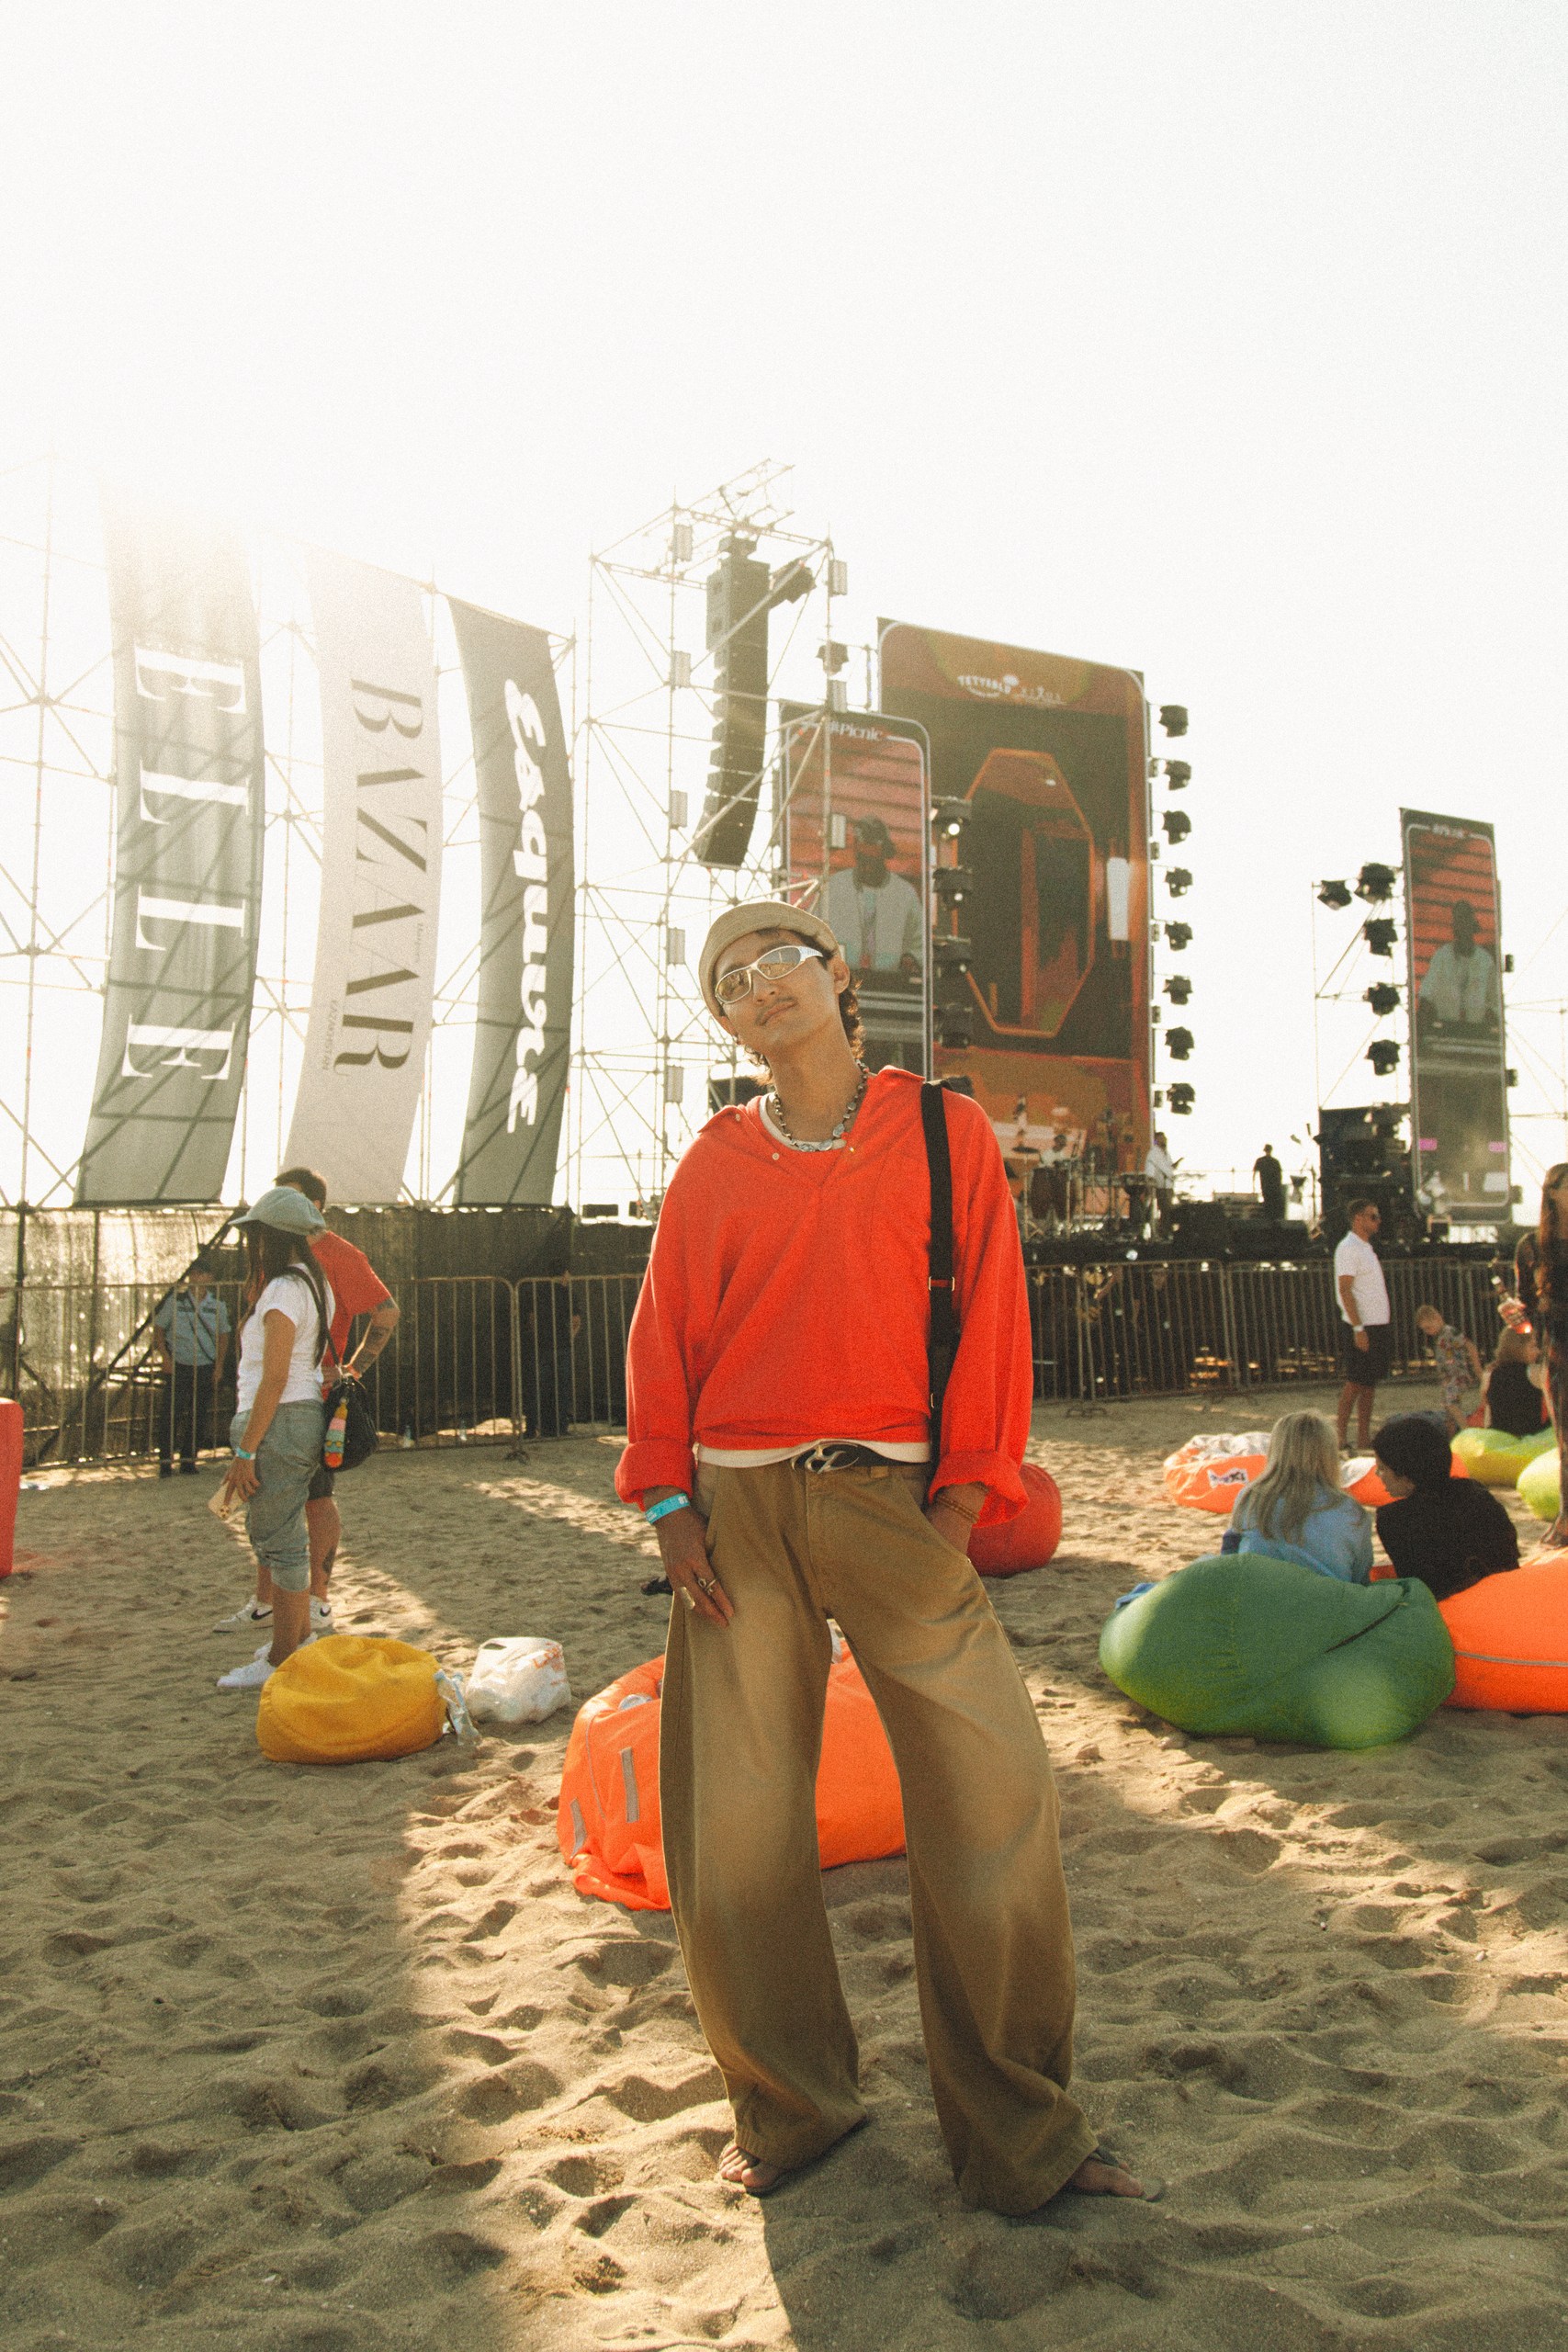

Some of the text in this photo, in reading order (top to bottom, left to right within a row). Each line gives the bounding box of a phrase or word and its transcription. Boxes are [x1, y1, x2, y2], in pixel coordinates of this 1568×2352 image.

[121, 640, 249, 1080] ELLE
[321, 999, 338, 1070] KAZAKHSTAN
[333, 678, 428, 1077] BAZAAR
[505, 678, 547, 1134] Esquire
